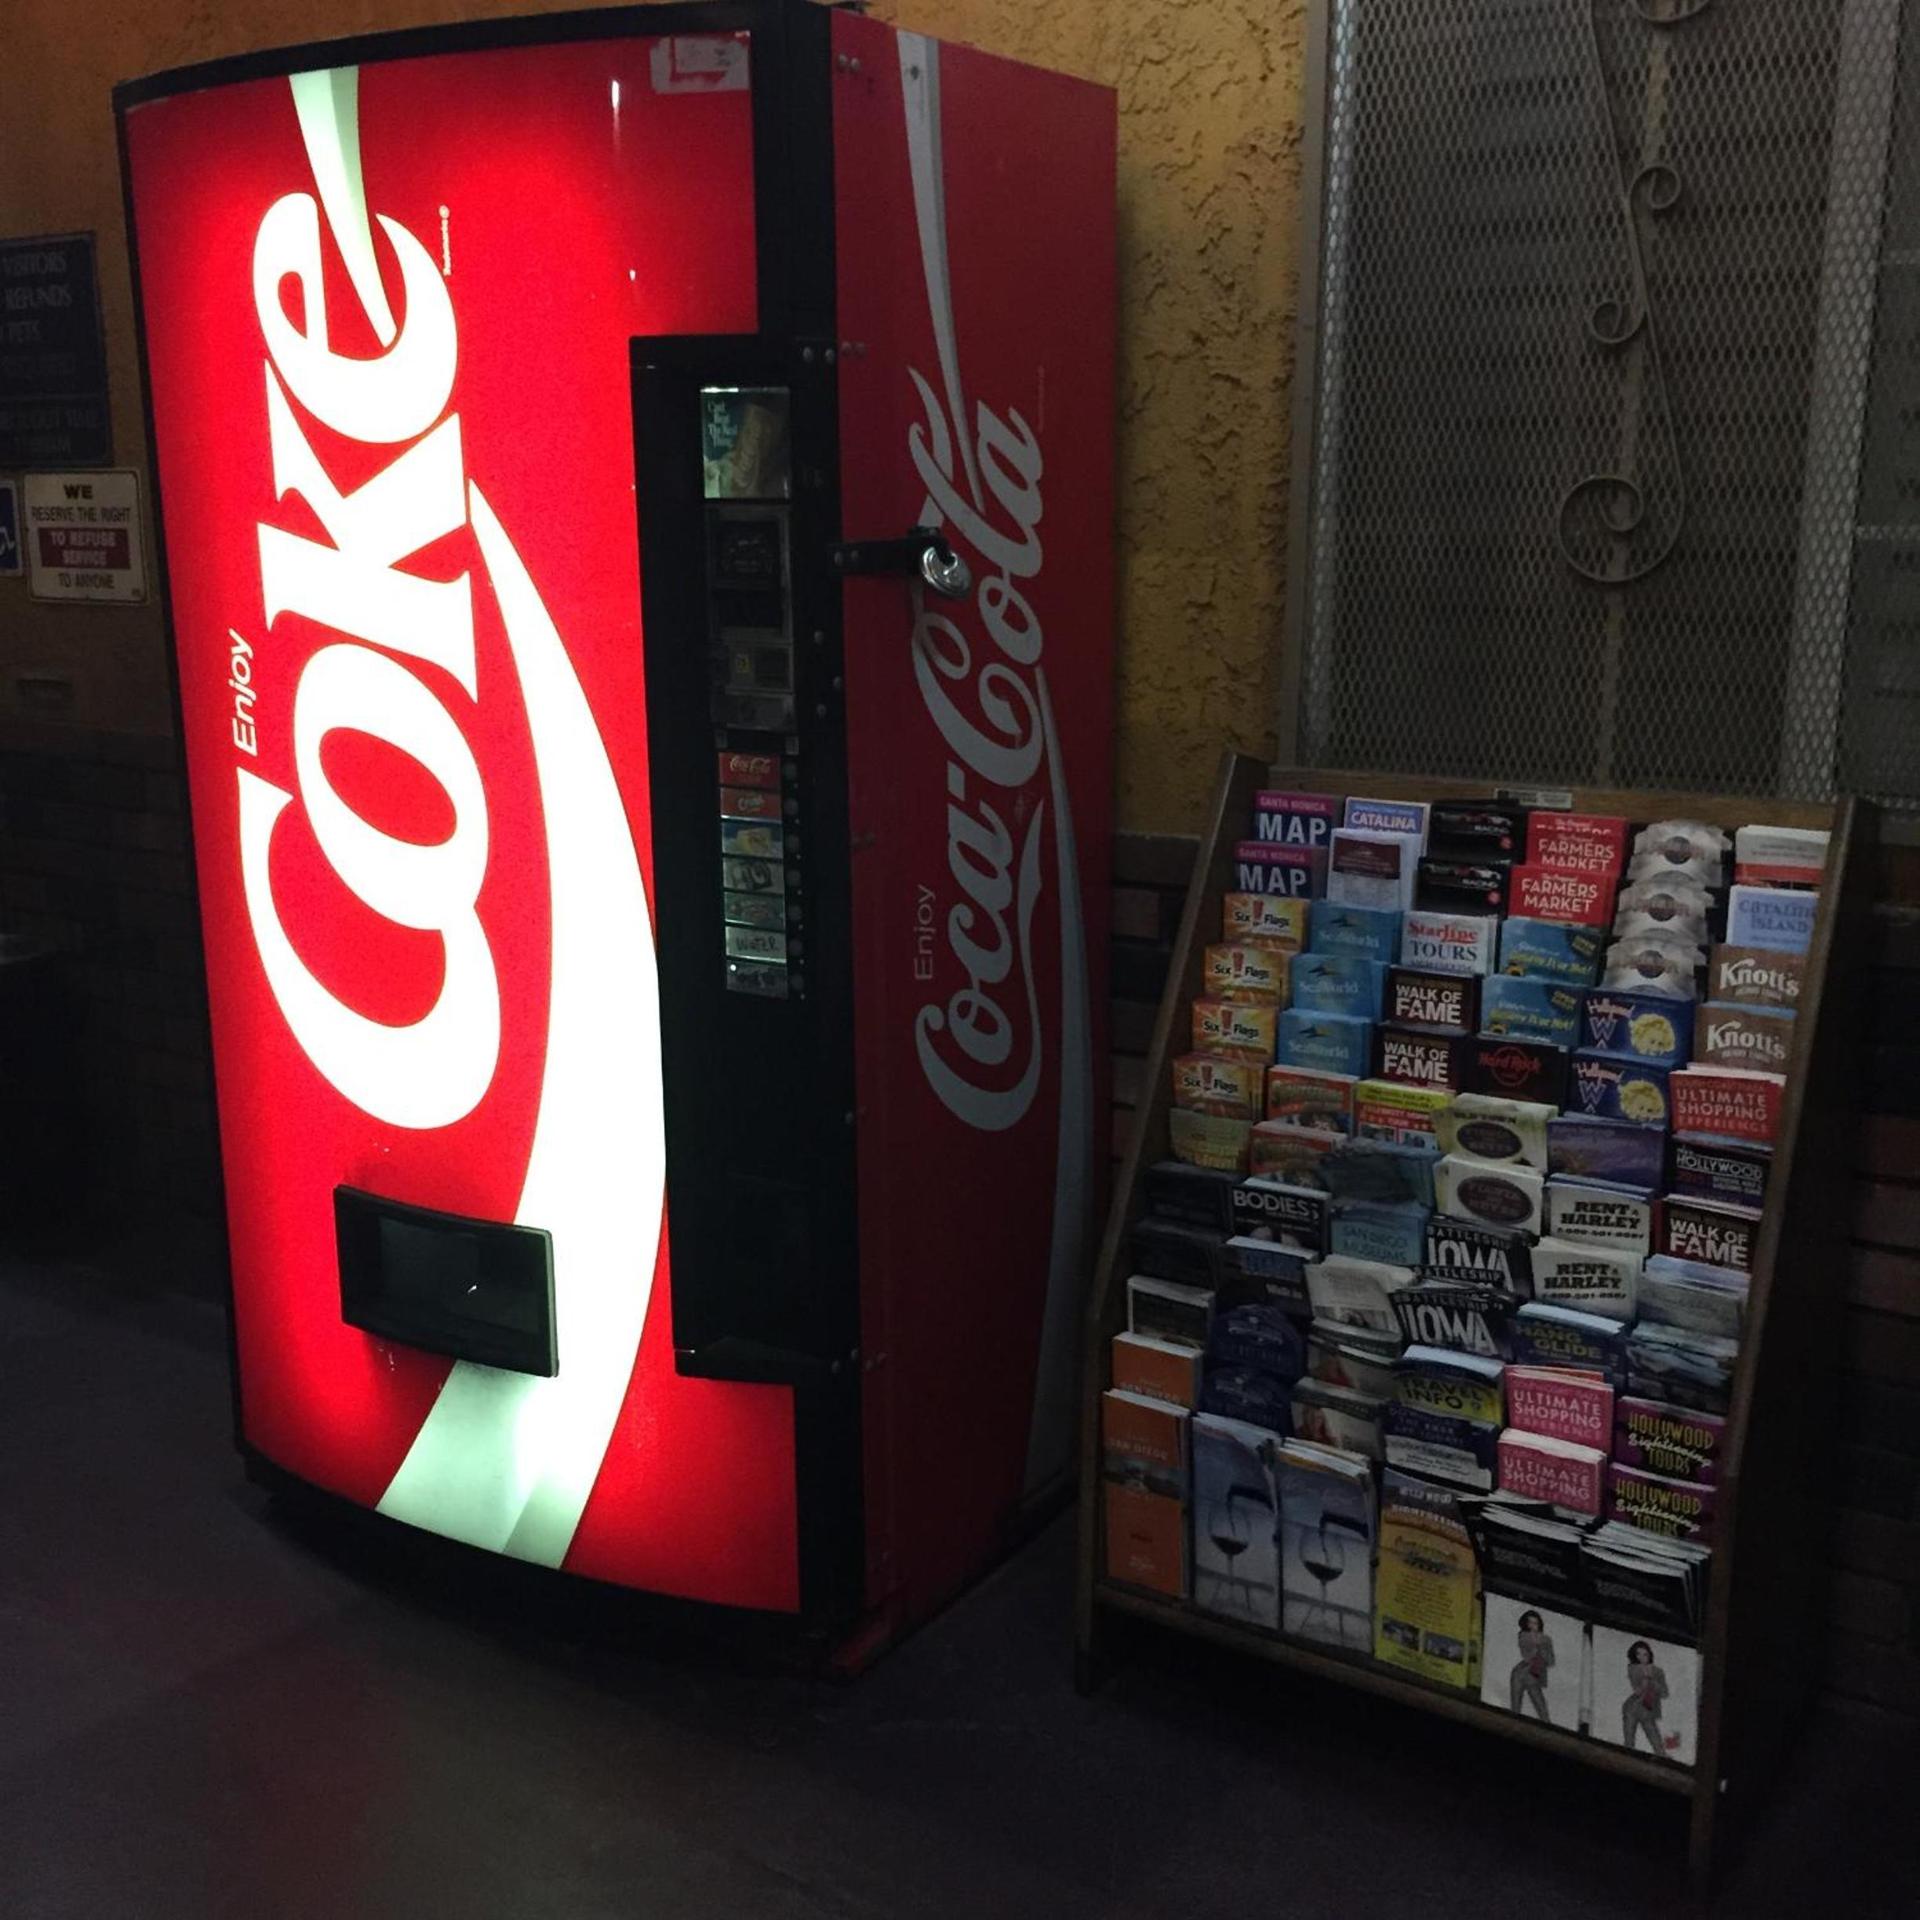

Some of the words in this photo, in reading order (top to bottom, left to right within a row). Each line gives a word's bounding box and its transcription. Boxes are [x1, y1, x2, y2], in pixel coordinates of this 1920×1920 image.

[63, 484, 93, 499] WE
[31, 506, 74, 521] RESERVE
[77, 507, 97, 522] THE
[101, 507, 130, 521] RIGHT
[50, 530, 66, 546] TO
[69, 530, 116, 547] REFUSE
[62, 550, 107, 566] SERVICE
[238, 194, 500, 1131] Coke
[228, 628, 258, 756] Enjoy
[908, 366, 1045, 1132] Coca-Cola
[1258, 812, 1327, 845] MAP
[1538, 838, 1615, 860] FARMERS
[1542, 855, 1611, 872] MARKET
[1239, 863, 1307, 896] MAP
[1521, 878, 1599, 899] FARMERS
[1524, 895, 1594, 914] MARKET
[913, 884, 937, 980] Enjoy
[1234, 911, 1251, 921] Six
[1264, 913, 1290, 928] Flags
[1409, 940, 1477, 961] TOURS
[1214, 964, 1231, 975] Six
[1245, 966, 1270, 980] Flags
[1720, 958, 1799, 997] Knott's
[1395, 983, 1438, 1000] WALK
[1441, 991, 1463, 1003] OF
[1395, 997, 1462, 1024] FAME
[1204, 1020, 1219, 1031] Six
[1234, 1024, 1259, 1038] Flags
[1706, 1020, 1787, 1060] Knott's
[1383, 1041, 1426, 1059] WALK
[1429, 1048, 1449, 1062] OF
[1383, 1054, 1449, 1083] FAME
[1676, 1088, 1767, 1108] ULTIMATE
[1678, 1101, 1768, 1121] SHOPPING
[1676, 1153, 1763, 1181] HOLLYWOOD
[1232, 1189, 1310, 1217] BODIES
[1575, 1201, 1630, 1215] RENT
[1561, 1213, 1640, 1229] HARLEY
[1669, 1217, 1720, 1241] WALK
[1723, 1230, 1749, 1244] OF
[1669, 1232, 1749, 1267] FAME
[1427, 1236, 1514, 1293] IOWA
[1557, 1263, 1610, 1276] RENT
[1544, 1276, 1622, 1289] HARLEY
[1403, 1303, 1499, 1356] IOWA
[1513, 1389, 1601, 1416] ULTIMATE
[1514, 1402, 1602, 1429] SHOPPING
[1627, 1411, 1715, 1450] HOLLYWOOD
[1504, 1456, 1591, 1487] ULTIMATE
[1504, 1468, 1590, 1500] SHOPPING
[1615, 1479, 1703, 1516] HOLLYWOOD
